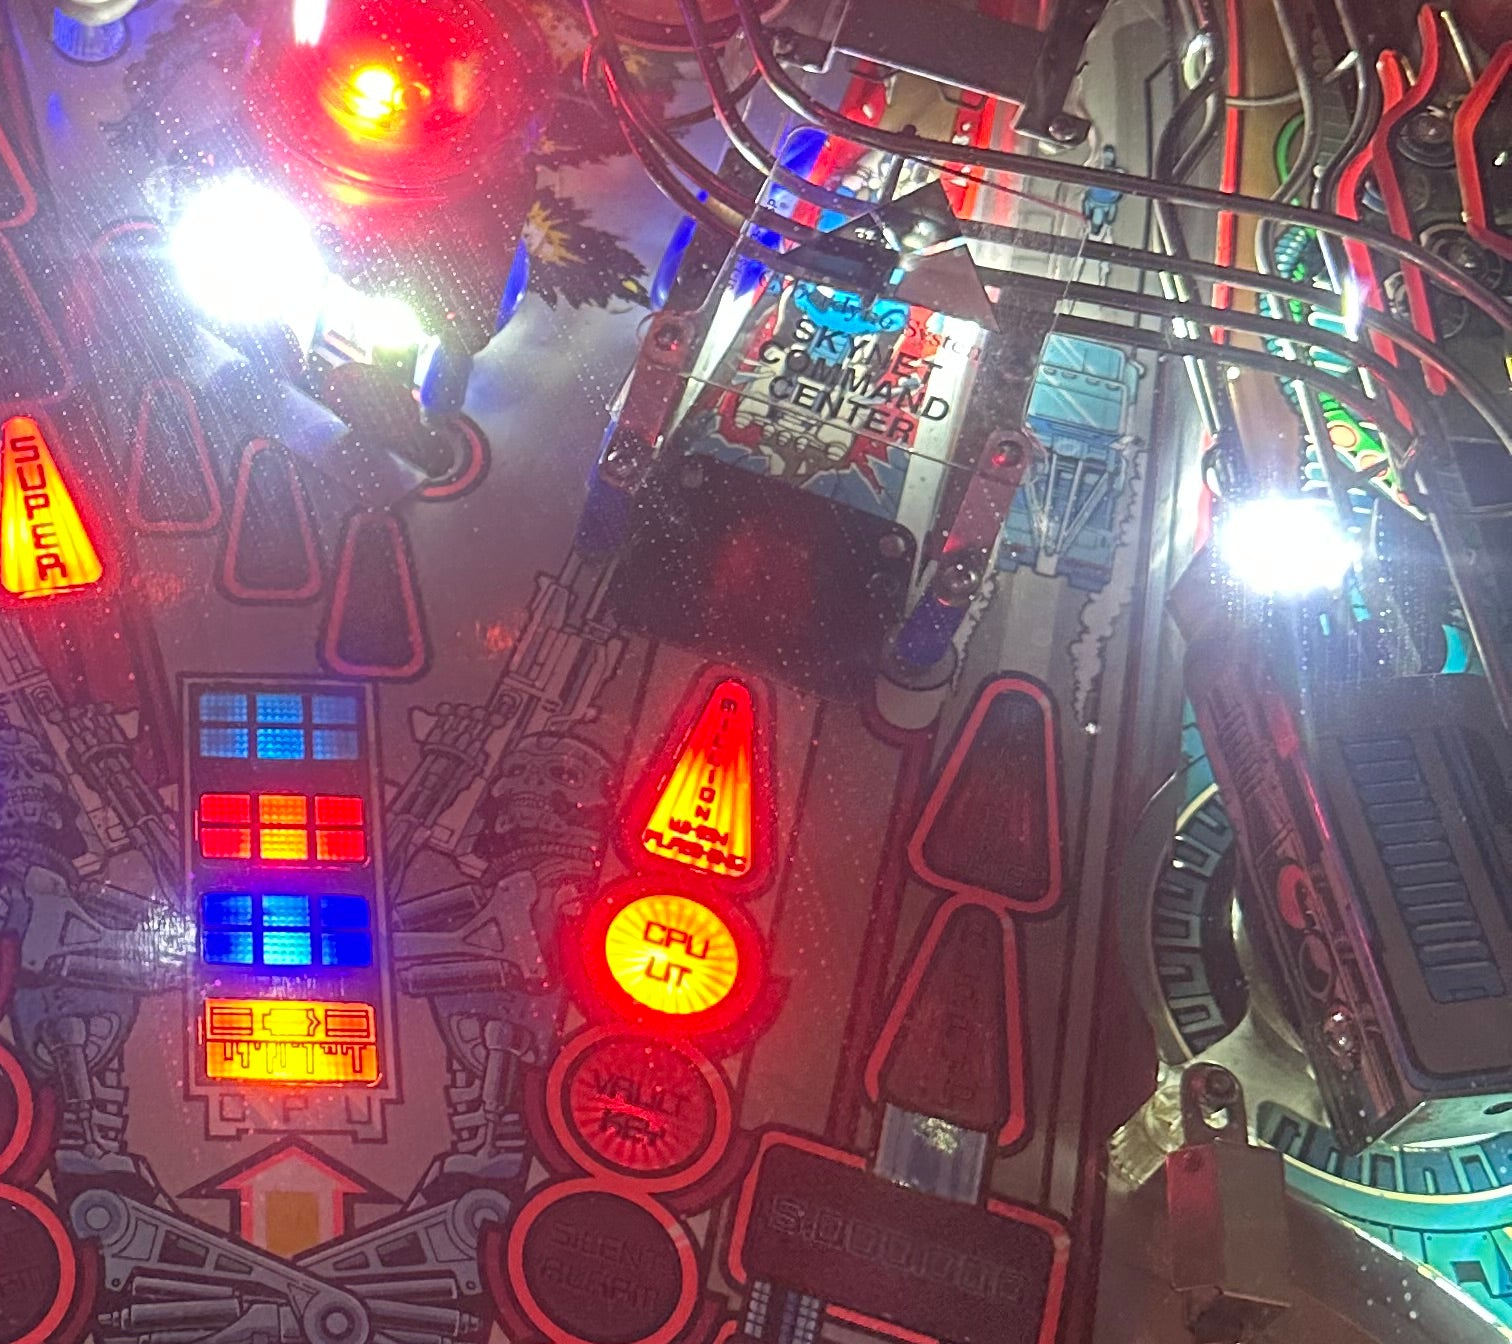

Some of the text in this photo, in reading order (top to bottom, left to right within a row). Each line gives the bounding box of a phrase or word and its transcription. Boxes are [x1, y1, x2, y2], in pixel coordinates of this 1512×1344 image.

[758, 340, 949, 422] COMMAND
[793, 319, 942, 384] SKYNET
[769, 376, 917, 448] CENTER
[11, 436, 68, 583] SUPER
[643, 922, 709, 960] CPU
